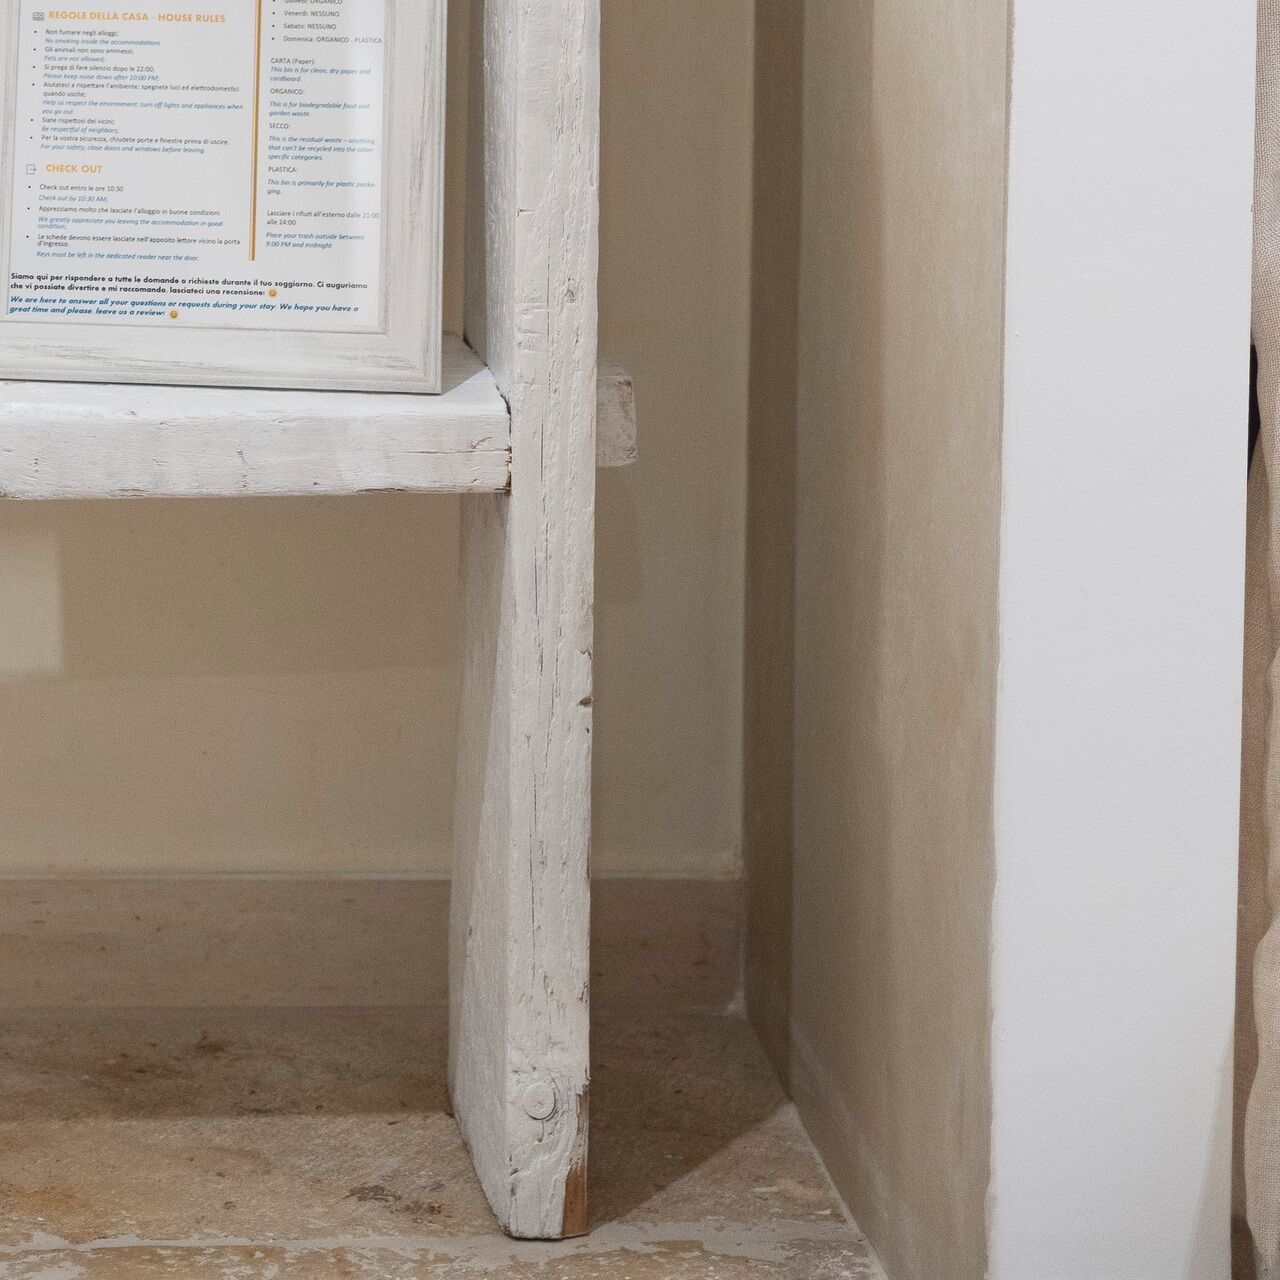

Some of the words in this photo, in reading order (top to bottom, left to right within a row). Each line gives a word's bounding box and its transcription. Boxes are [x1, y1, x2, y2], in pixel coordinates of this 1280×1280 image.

[49, 11, 87, 20] REGOLE
[89, 12, 121, 21] DELLA
[121, 12, 149, 21] CASA
[158, 13, 192, 22] HOUSE
[196, 14, 225, 23] RULES
[46, 164, 77, 173] CHECK
[82, 165, 101, 173] OUT
